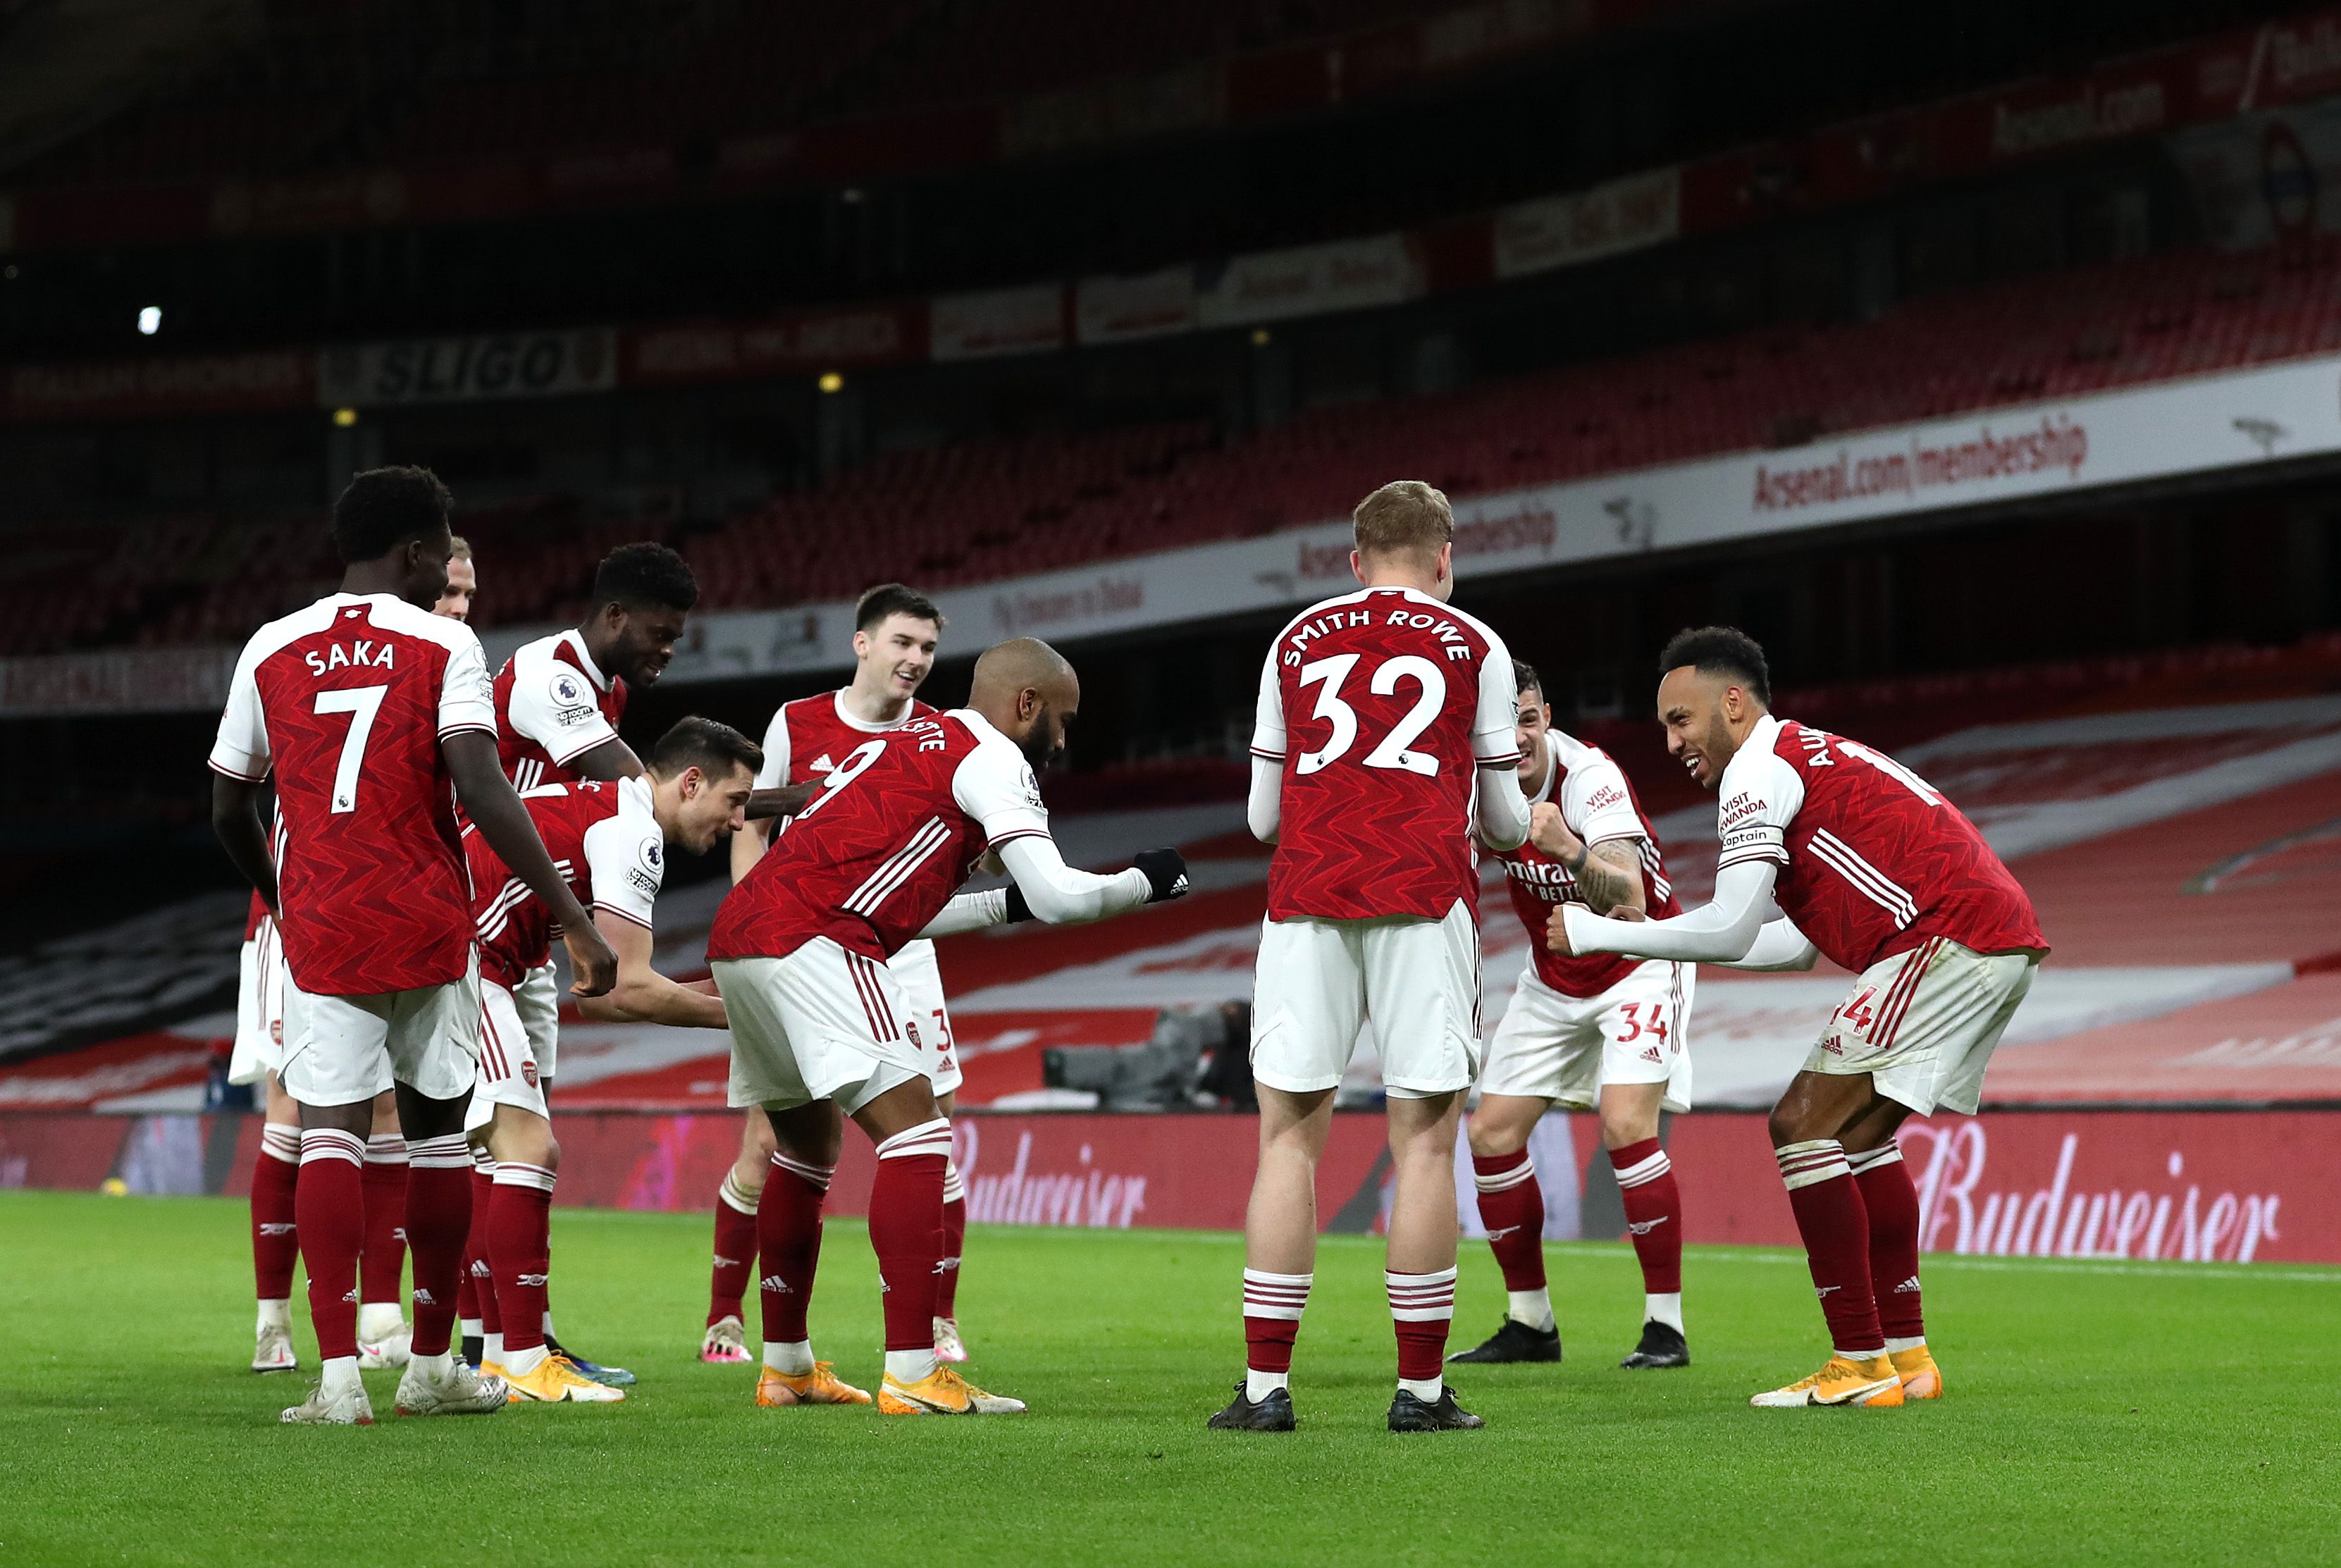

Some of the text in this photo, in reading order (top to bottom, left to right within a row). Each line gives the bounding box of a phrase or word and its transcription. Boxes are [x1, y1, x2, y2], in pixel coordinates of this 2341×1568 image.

[377, 338, 564, 396] SLIGO
[305, 640, 393, 677] SAKA
[1284, 610, 1471, 667] SMITH ROWE
[1296, 653, 1447, 777] 32
[314, 684, 388, 814] 7
[794, 739, 887, 820] 9
[1586, 785, 1612, 807] VISIT
[1722, 791, 1748, 813] VISIT
[932, 1008, 951, 1051] 3
[1617, 1002, 1668, 1046] 34
[1897, 1121, 2280, 1264] Budweiser
